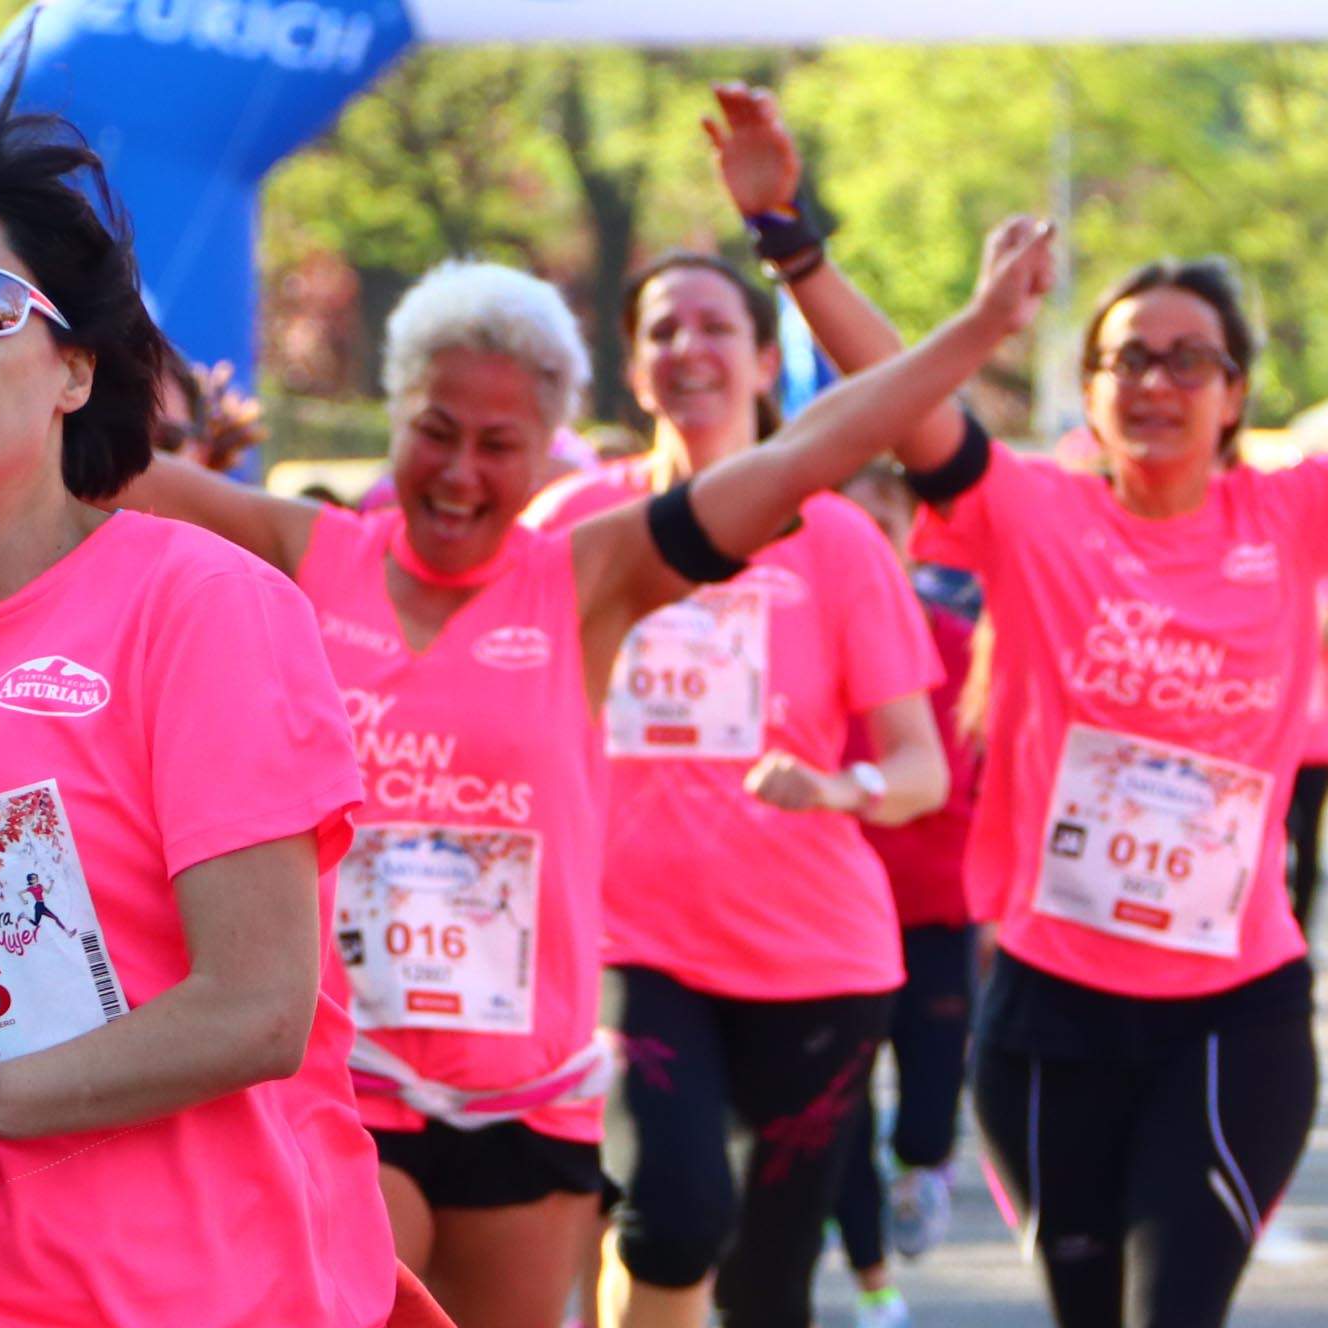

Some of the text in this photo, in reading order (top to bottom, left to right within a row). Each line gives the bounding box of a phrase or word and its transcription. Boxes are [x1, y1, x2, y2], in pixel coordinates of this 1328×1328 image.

[1085, 623, 1227, 678] GANAN
[629, 667, 708, 701] 016
[337, 687, 398, 727] OY
[377, 769, 535, 824] CHICAS
[1107, 832, 1195, 883] 016
[384, 922, 469, 960] 016
